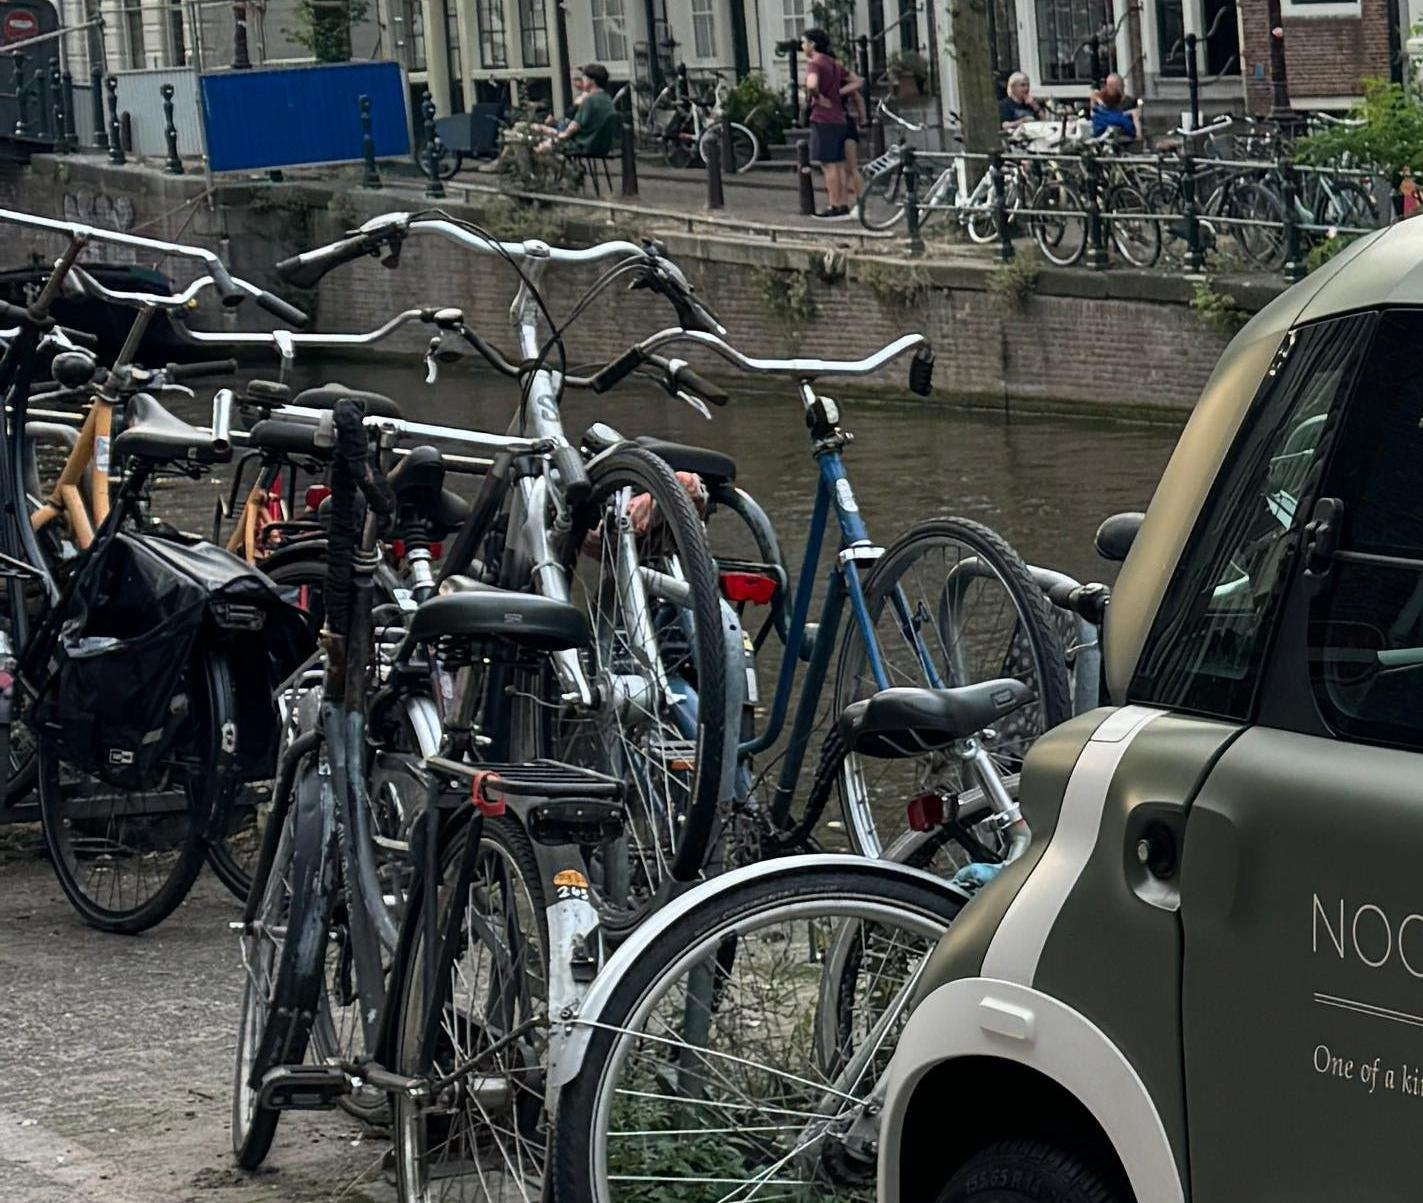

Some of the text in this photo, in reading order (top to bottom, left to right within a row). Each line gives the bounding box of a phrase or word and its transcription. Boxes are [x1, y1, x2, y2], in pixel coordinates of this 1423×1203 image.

[1313, 1045, 1354, 1080] One
[1360, 1058, 1380, 1094] of
[1384, 1069, 1395, 1089] a
